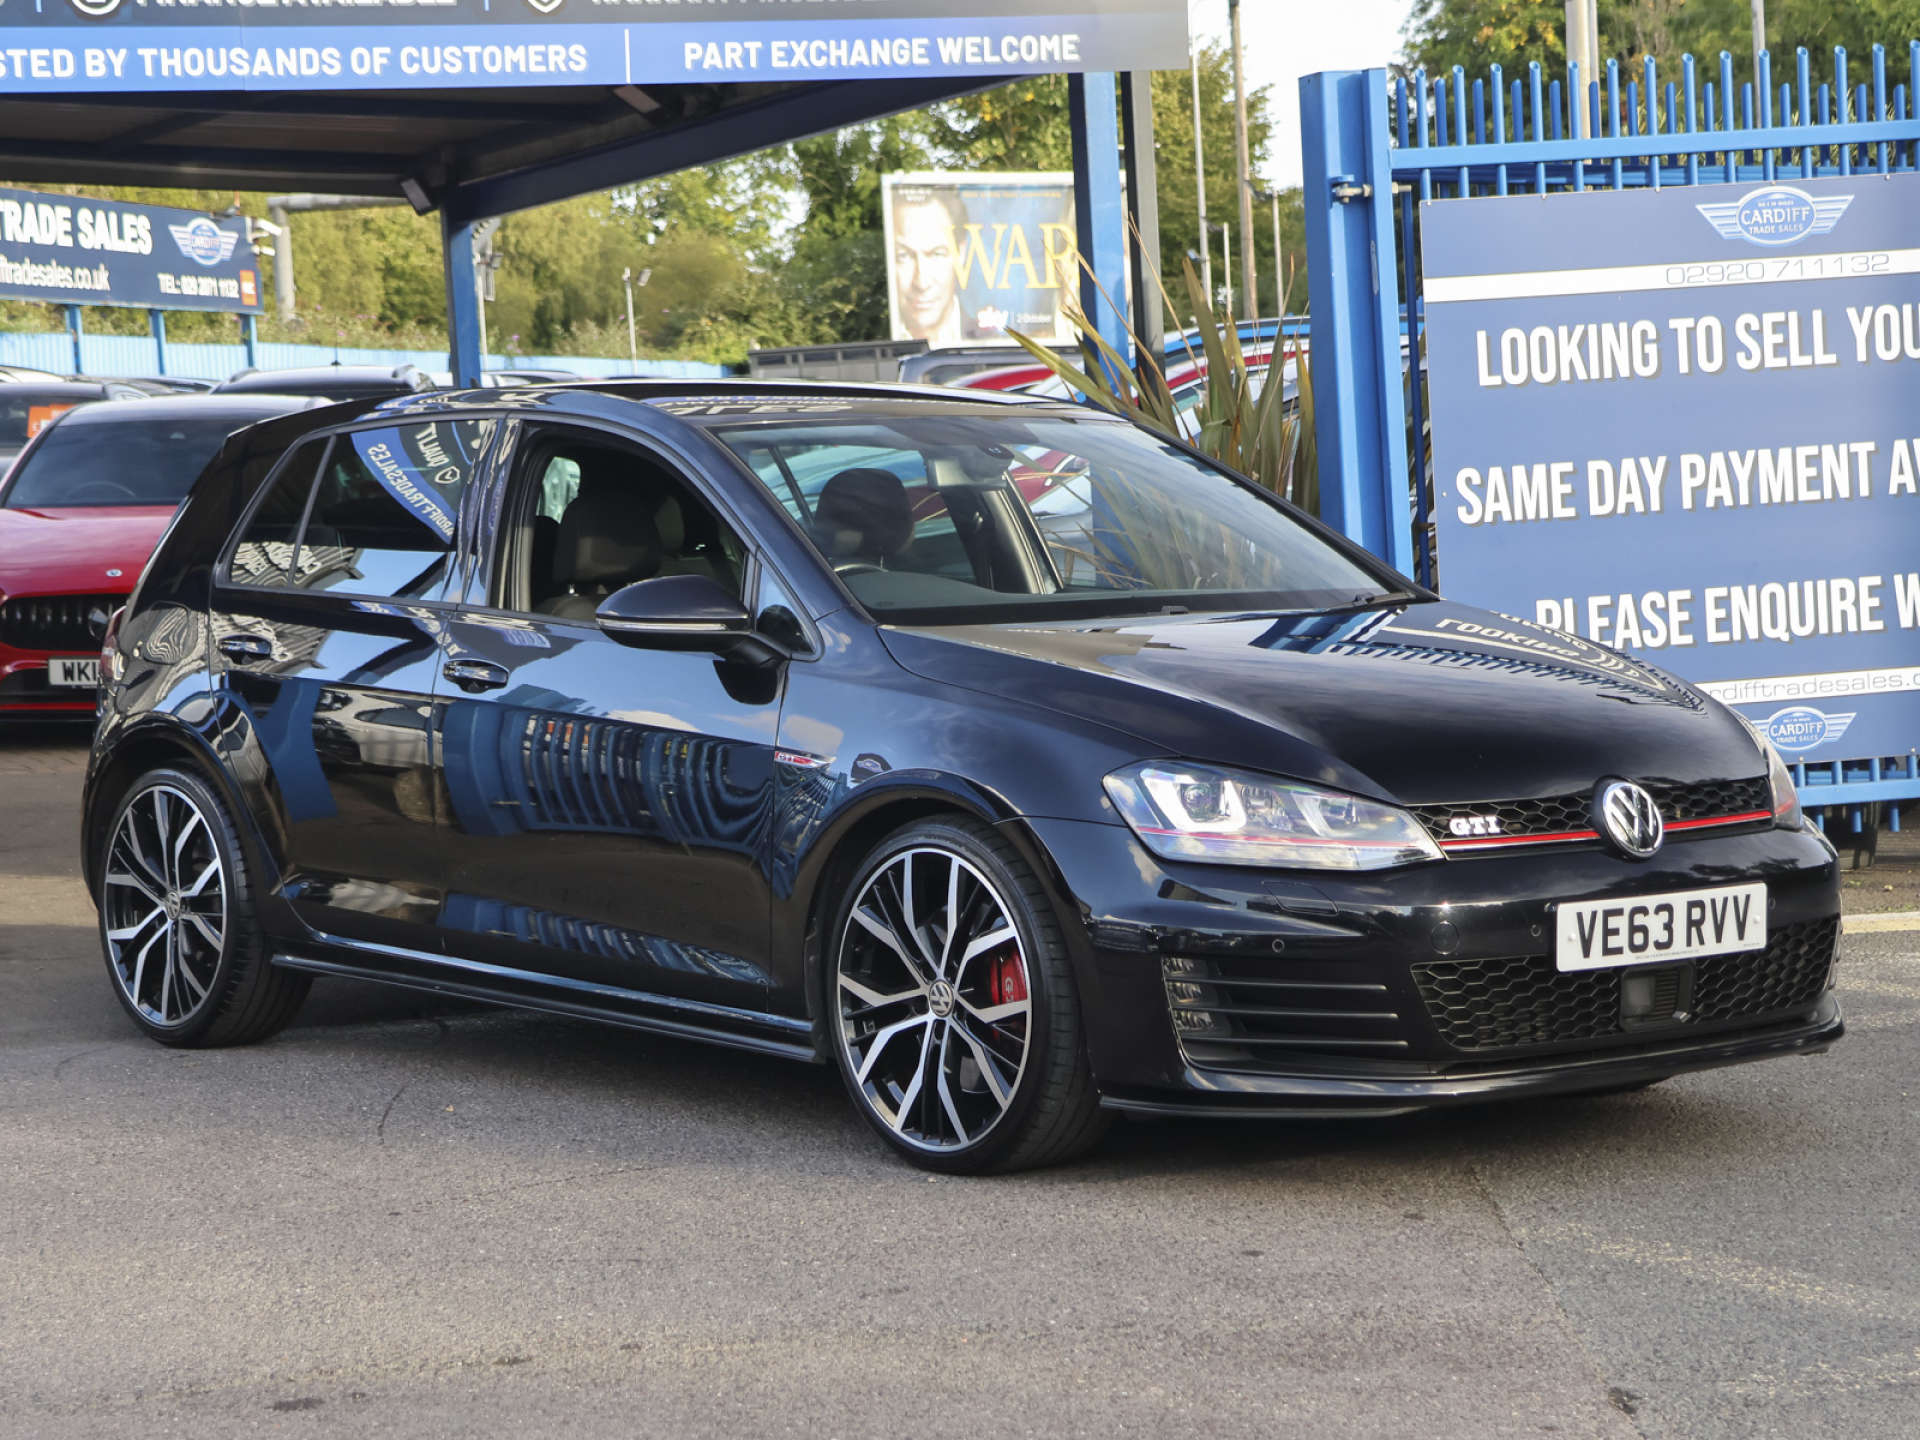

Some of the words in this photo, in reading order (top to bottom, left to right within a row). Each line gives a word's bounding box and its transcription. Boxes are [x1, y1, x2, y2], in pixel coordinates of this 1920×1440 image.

[84, 48, 127, 77] BY
[137, 46, 341, 78] THOUSANDS
[350, 46, 391, 75] OF
[399, 44, 588, 75] CUSTOMERS
[684, 41, 762, 69] PART
[771, 37, 930, 68] EXCHANGE
[937, 34, 1081, 64] WELCOME
[77, 207, 153, 256] SALES
[1741, 206, 1811, 226] CARDIFF
[1749, 224, 1776, 235] TRADE
[1778, 222, 1804, 233] SALES
[1476, 319, 1659, 387] LOOKING
[1668, 315, 1724, 375] TO
[1735, 308, 1838, 372] SELL
[1456, 461, 1577, 526] SAME
[1587, 455, 1669, 517] DAY
[1680, 441, 1876, 510] PAYMENT
[1704, 575, 1884, 644] ENQUIRE
[1769, 721, 1823, 738] CARDIFF
[1449, 815, 1501, 837] GTI
[1576, 902, 1675, 959] VE63
[1685, 893, 1752, 948] RVV
